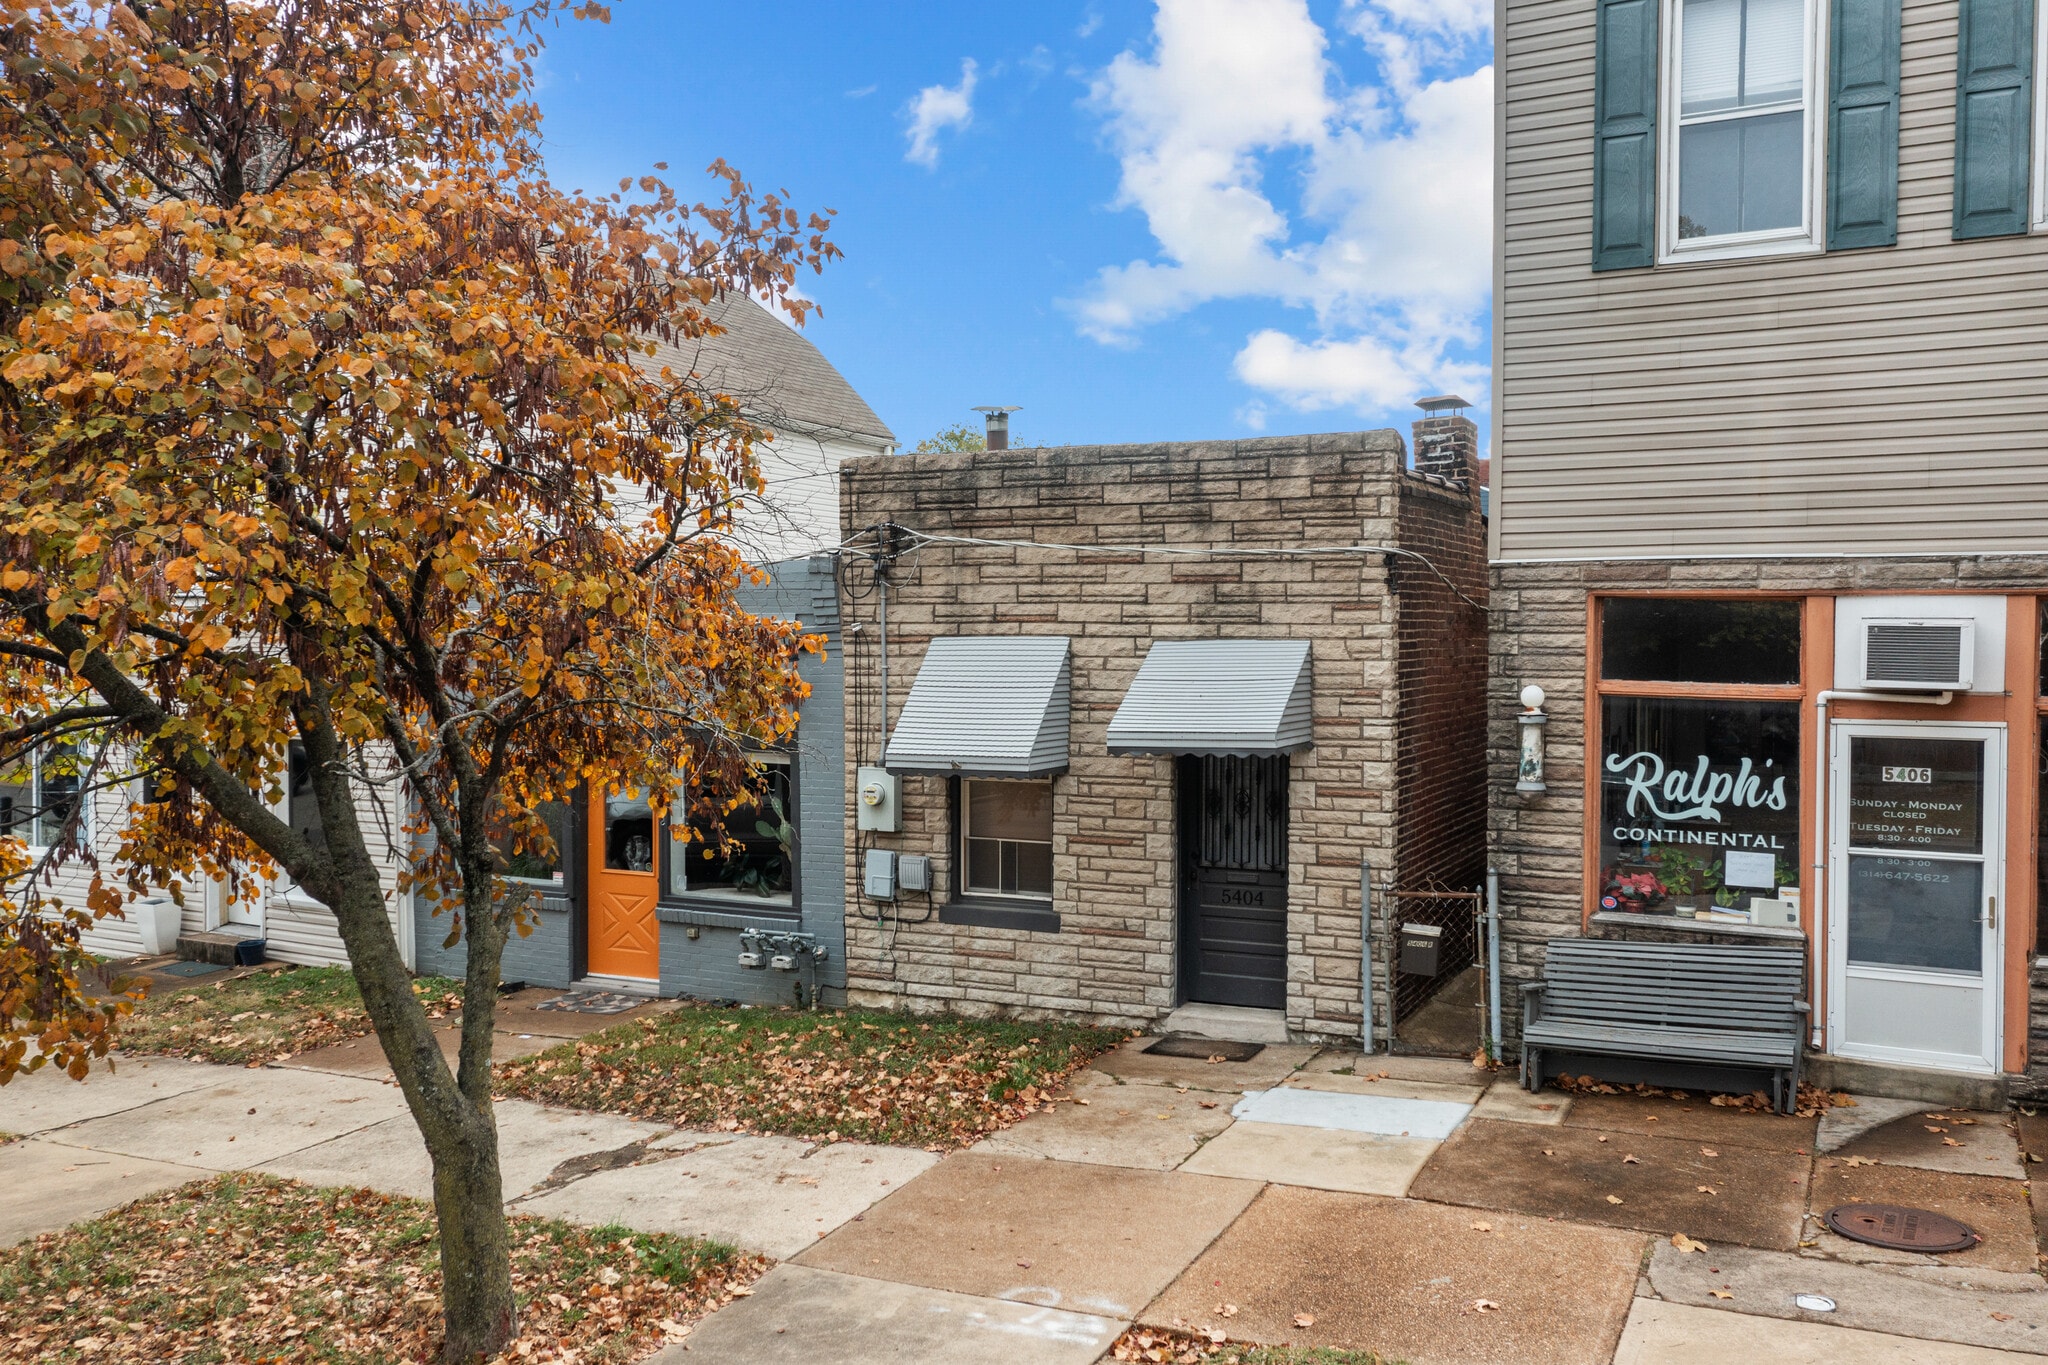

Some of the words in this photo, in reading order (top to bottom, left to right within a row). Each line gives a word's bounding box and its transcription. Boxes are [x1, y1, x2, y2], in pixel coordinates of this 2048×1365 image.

[1884, 767, 1930, 782] 5406
[1605, 751, 1787, 823] Ralph's
[1850, 798, 1898, 807] SUNDAY
[1908, 800, 1963, 811] MONDAY
[1882, 810, 1927, 819] CLOSED
[1850, 822, 1905, 833] TUESDAY
[1915, 825, 1962, 836] FRIDAY
[1612, 827, 1786, 850] CONTINENTAL
[1877, 834, 1901, 842] 8:30
[1908, 836, 1932, 844] 4:00
[1877, 858, 1900, 866] 8:30
[1907, 859, 1931, 867] 3:00
[1221, 889, 1265, 906] 5404
